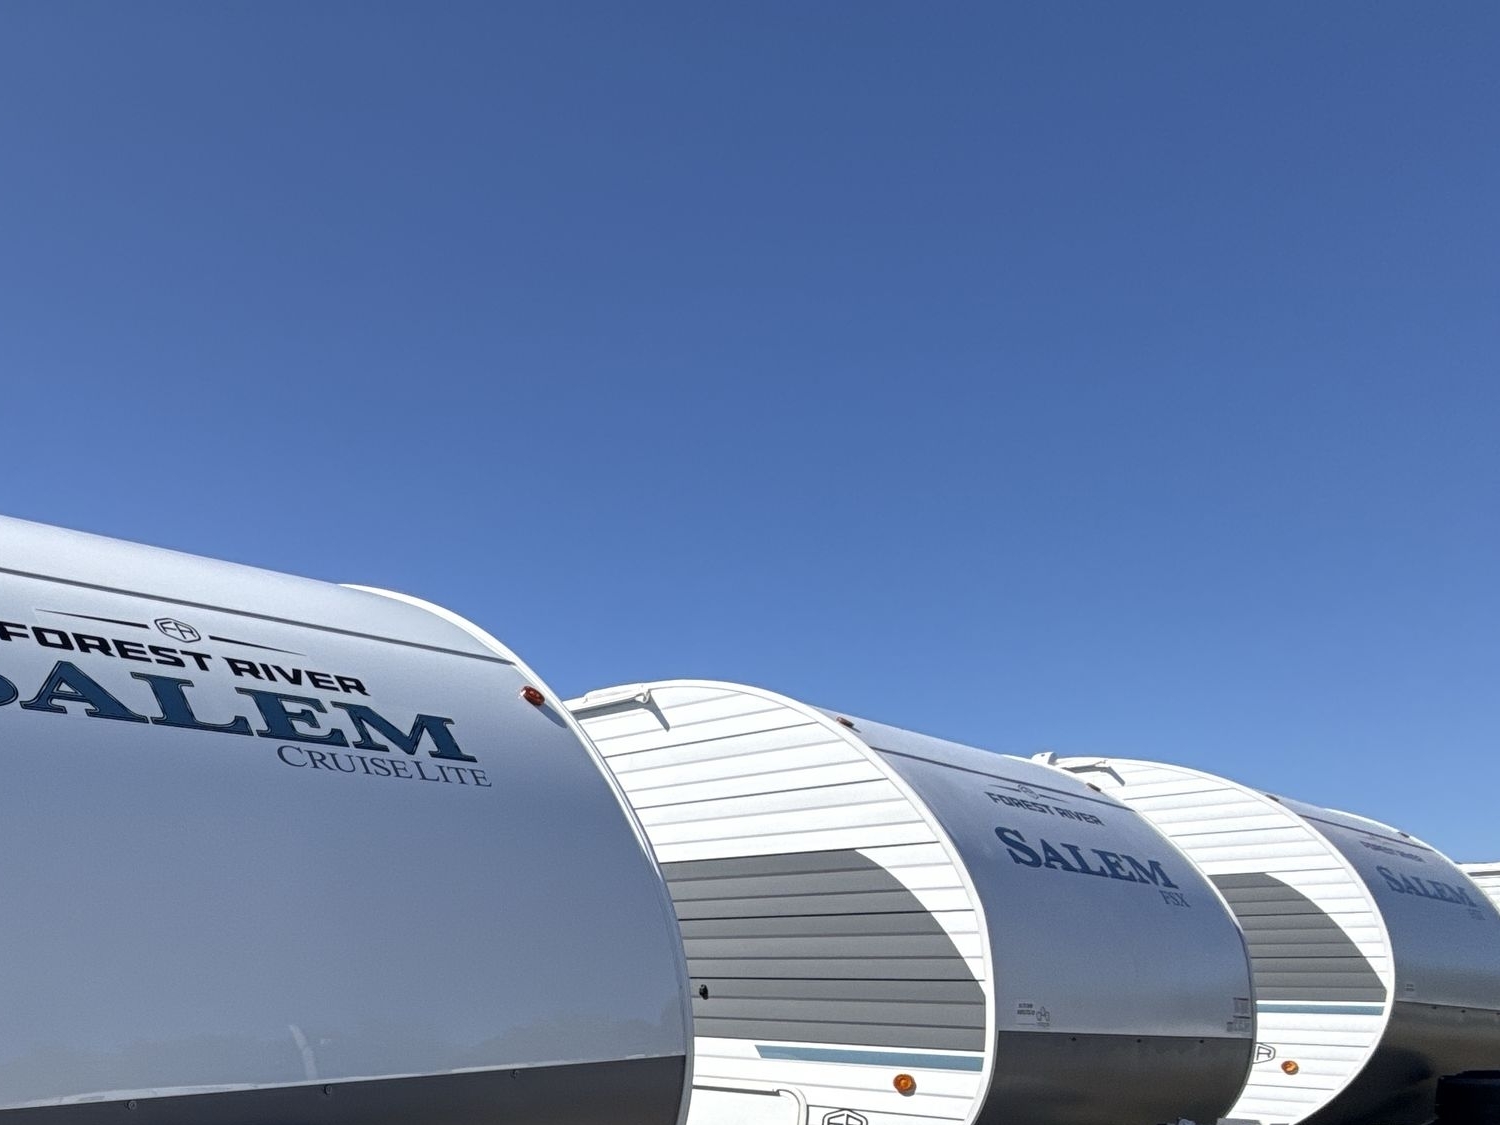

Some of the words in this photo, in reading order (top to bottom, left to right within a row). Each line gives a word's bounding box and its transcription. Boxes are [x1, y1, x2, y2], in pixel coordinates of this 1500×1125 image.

[221, 656, 370, 697] RIVER
[985, 791, 1054, 815] FOREST
[1055, 806, 1105, 827] RIVER
[994, 826, 1179, 890] SALEM
[1159, 889, 1191, 908] FSX
